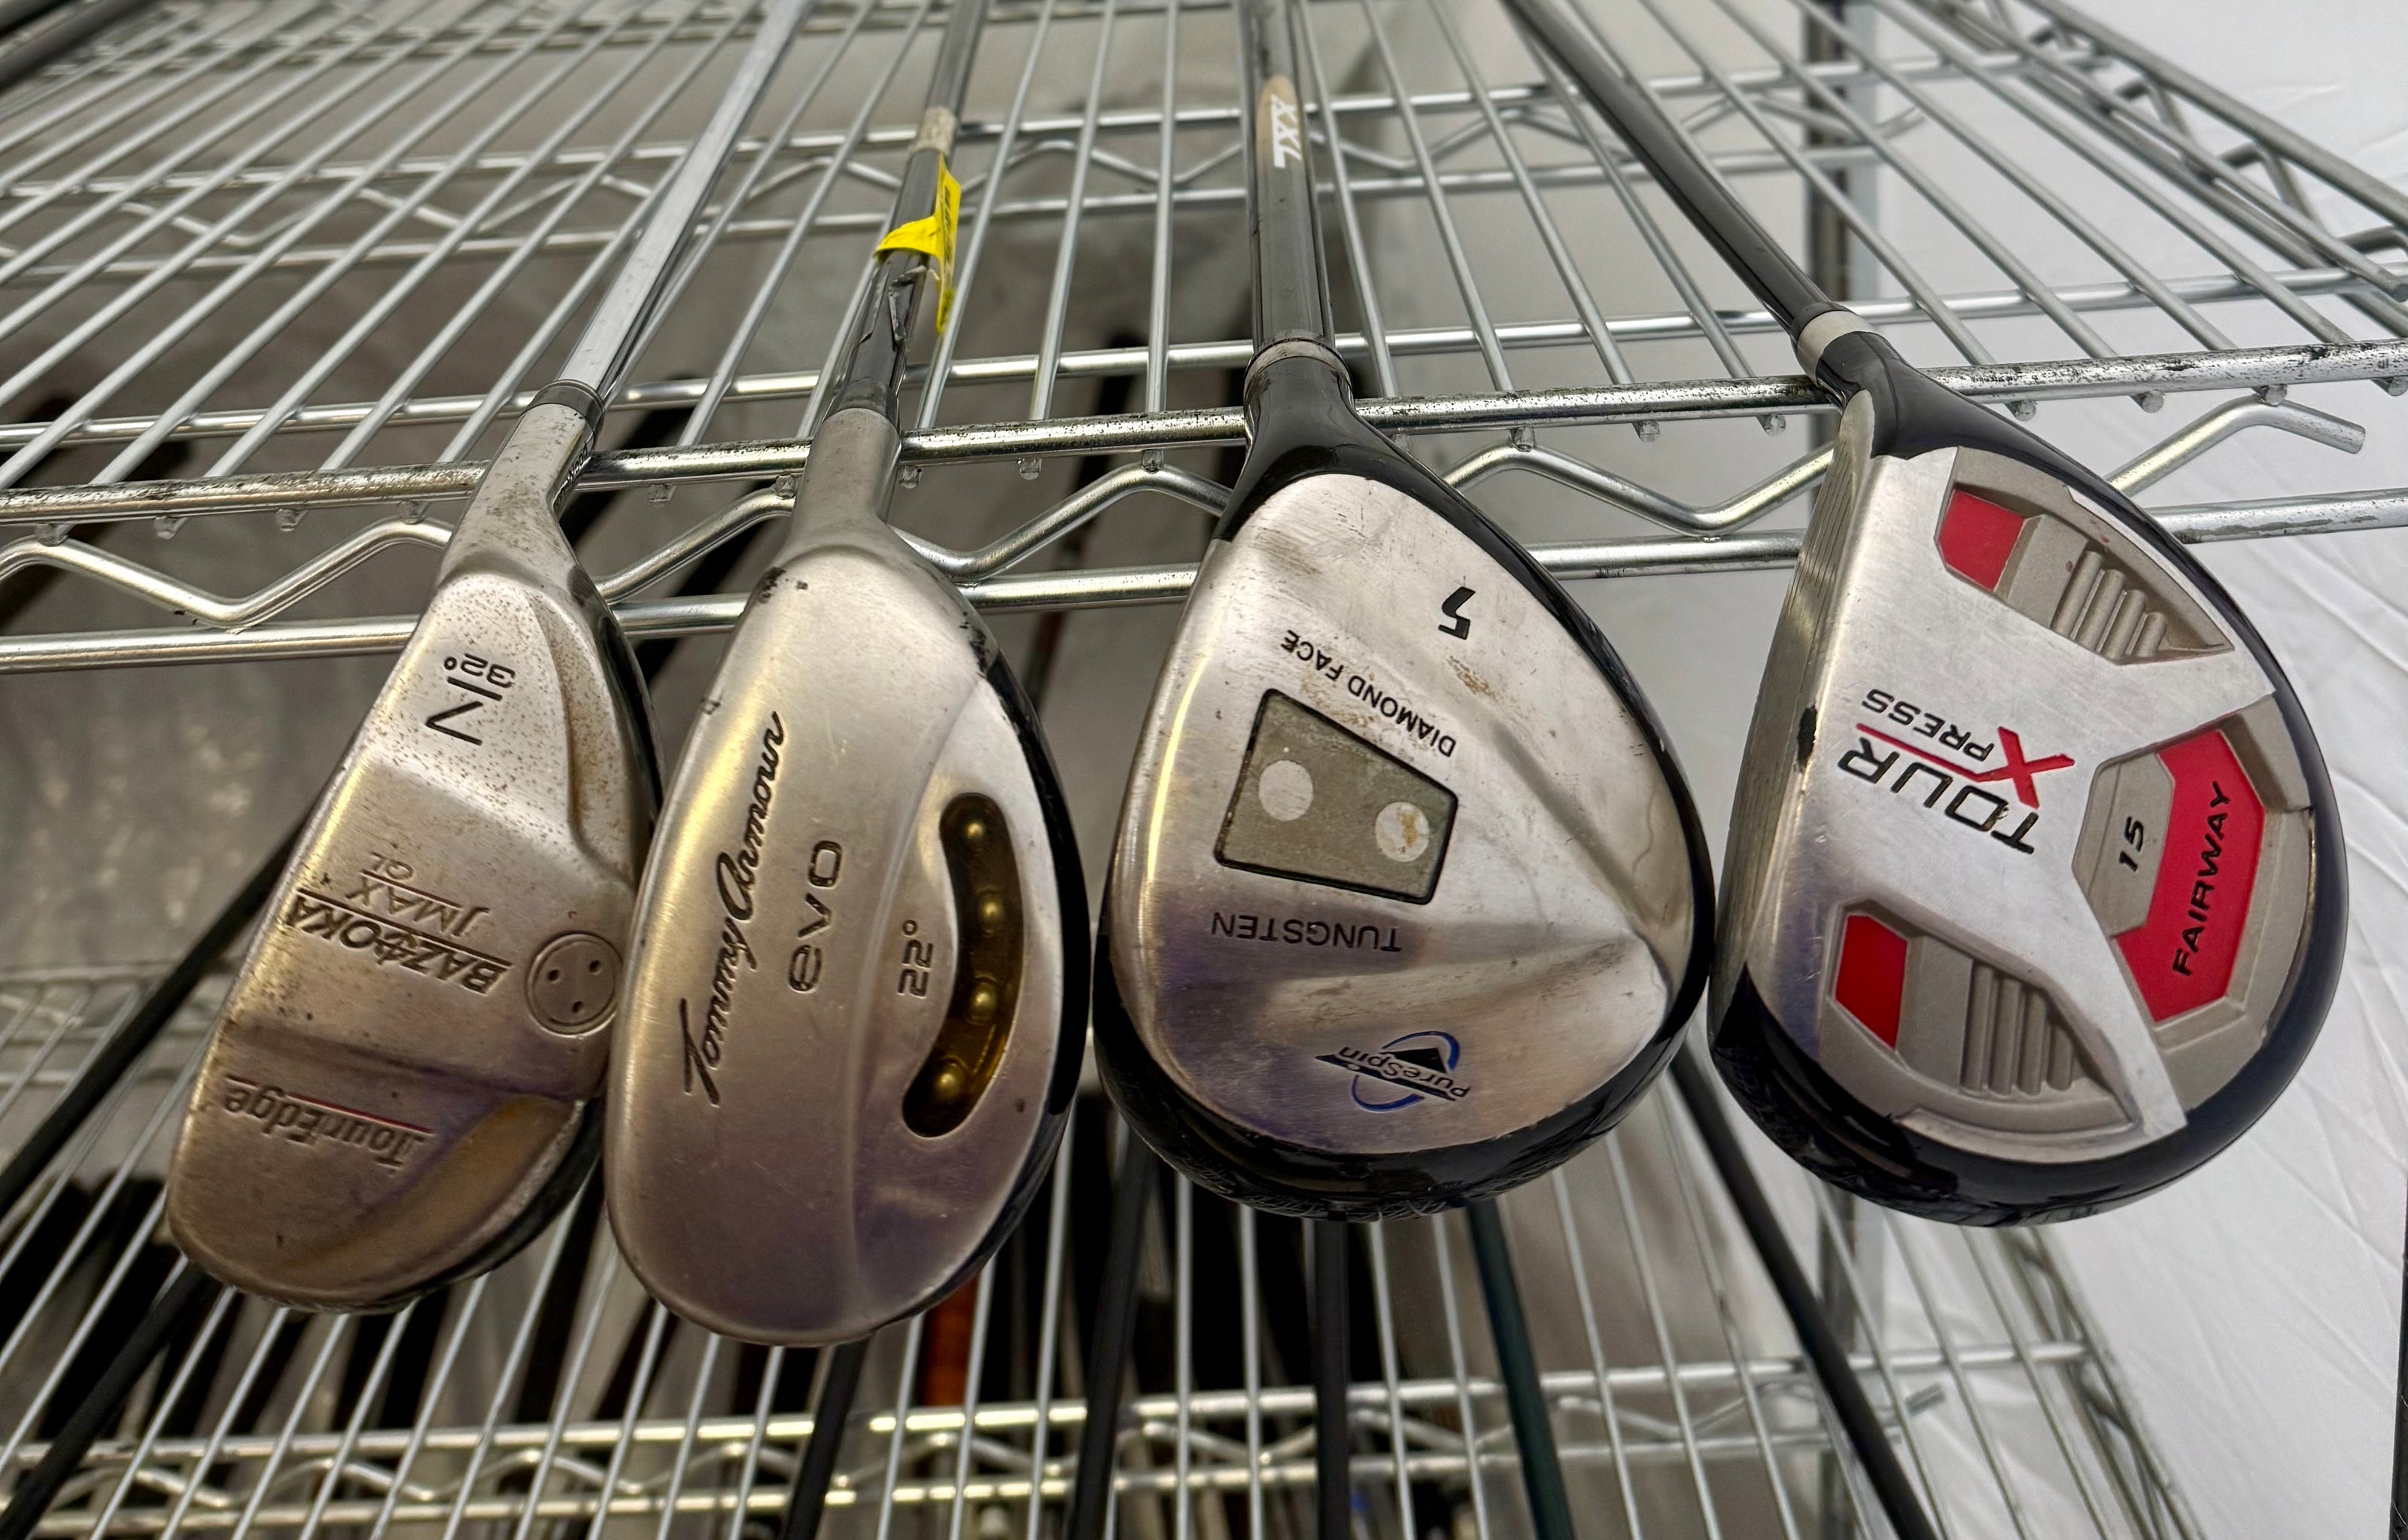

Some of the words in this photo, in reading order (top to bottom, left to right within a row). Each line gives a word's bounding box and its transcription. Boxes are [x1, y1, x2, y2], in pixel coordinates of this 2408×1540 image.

[1438, 586, 1476, 641] 5
[443, 653, 518, 689] 32°
[1279, 628, 1342, 679] FACE
[425, 700, 484, 746] 7
[1347, 674, 1458, 758] DIAMOND
[716, 711, 788, 922] Armour
[1837, 738, 2039, 855] TOUR
[368, 851, 415, 881] QL
[2118, 816, 2146, 872] 15
[346, 875, 489, 939] JMAX
[2172, 781, 2230, 977] FAIRWAY
[285, 896, 503, 994] BAZOOKA
[898, 918, 935, 1000] 22°
[1212, 911, 1403, 954] TUNGSTEN
[680, 915, 758, 1107] Tommy
[1338, 1044, 1472, 1100] PureSpin
